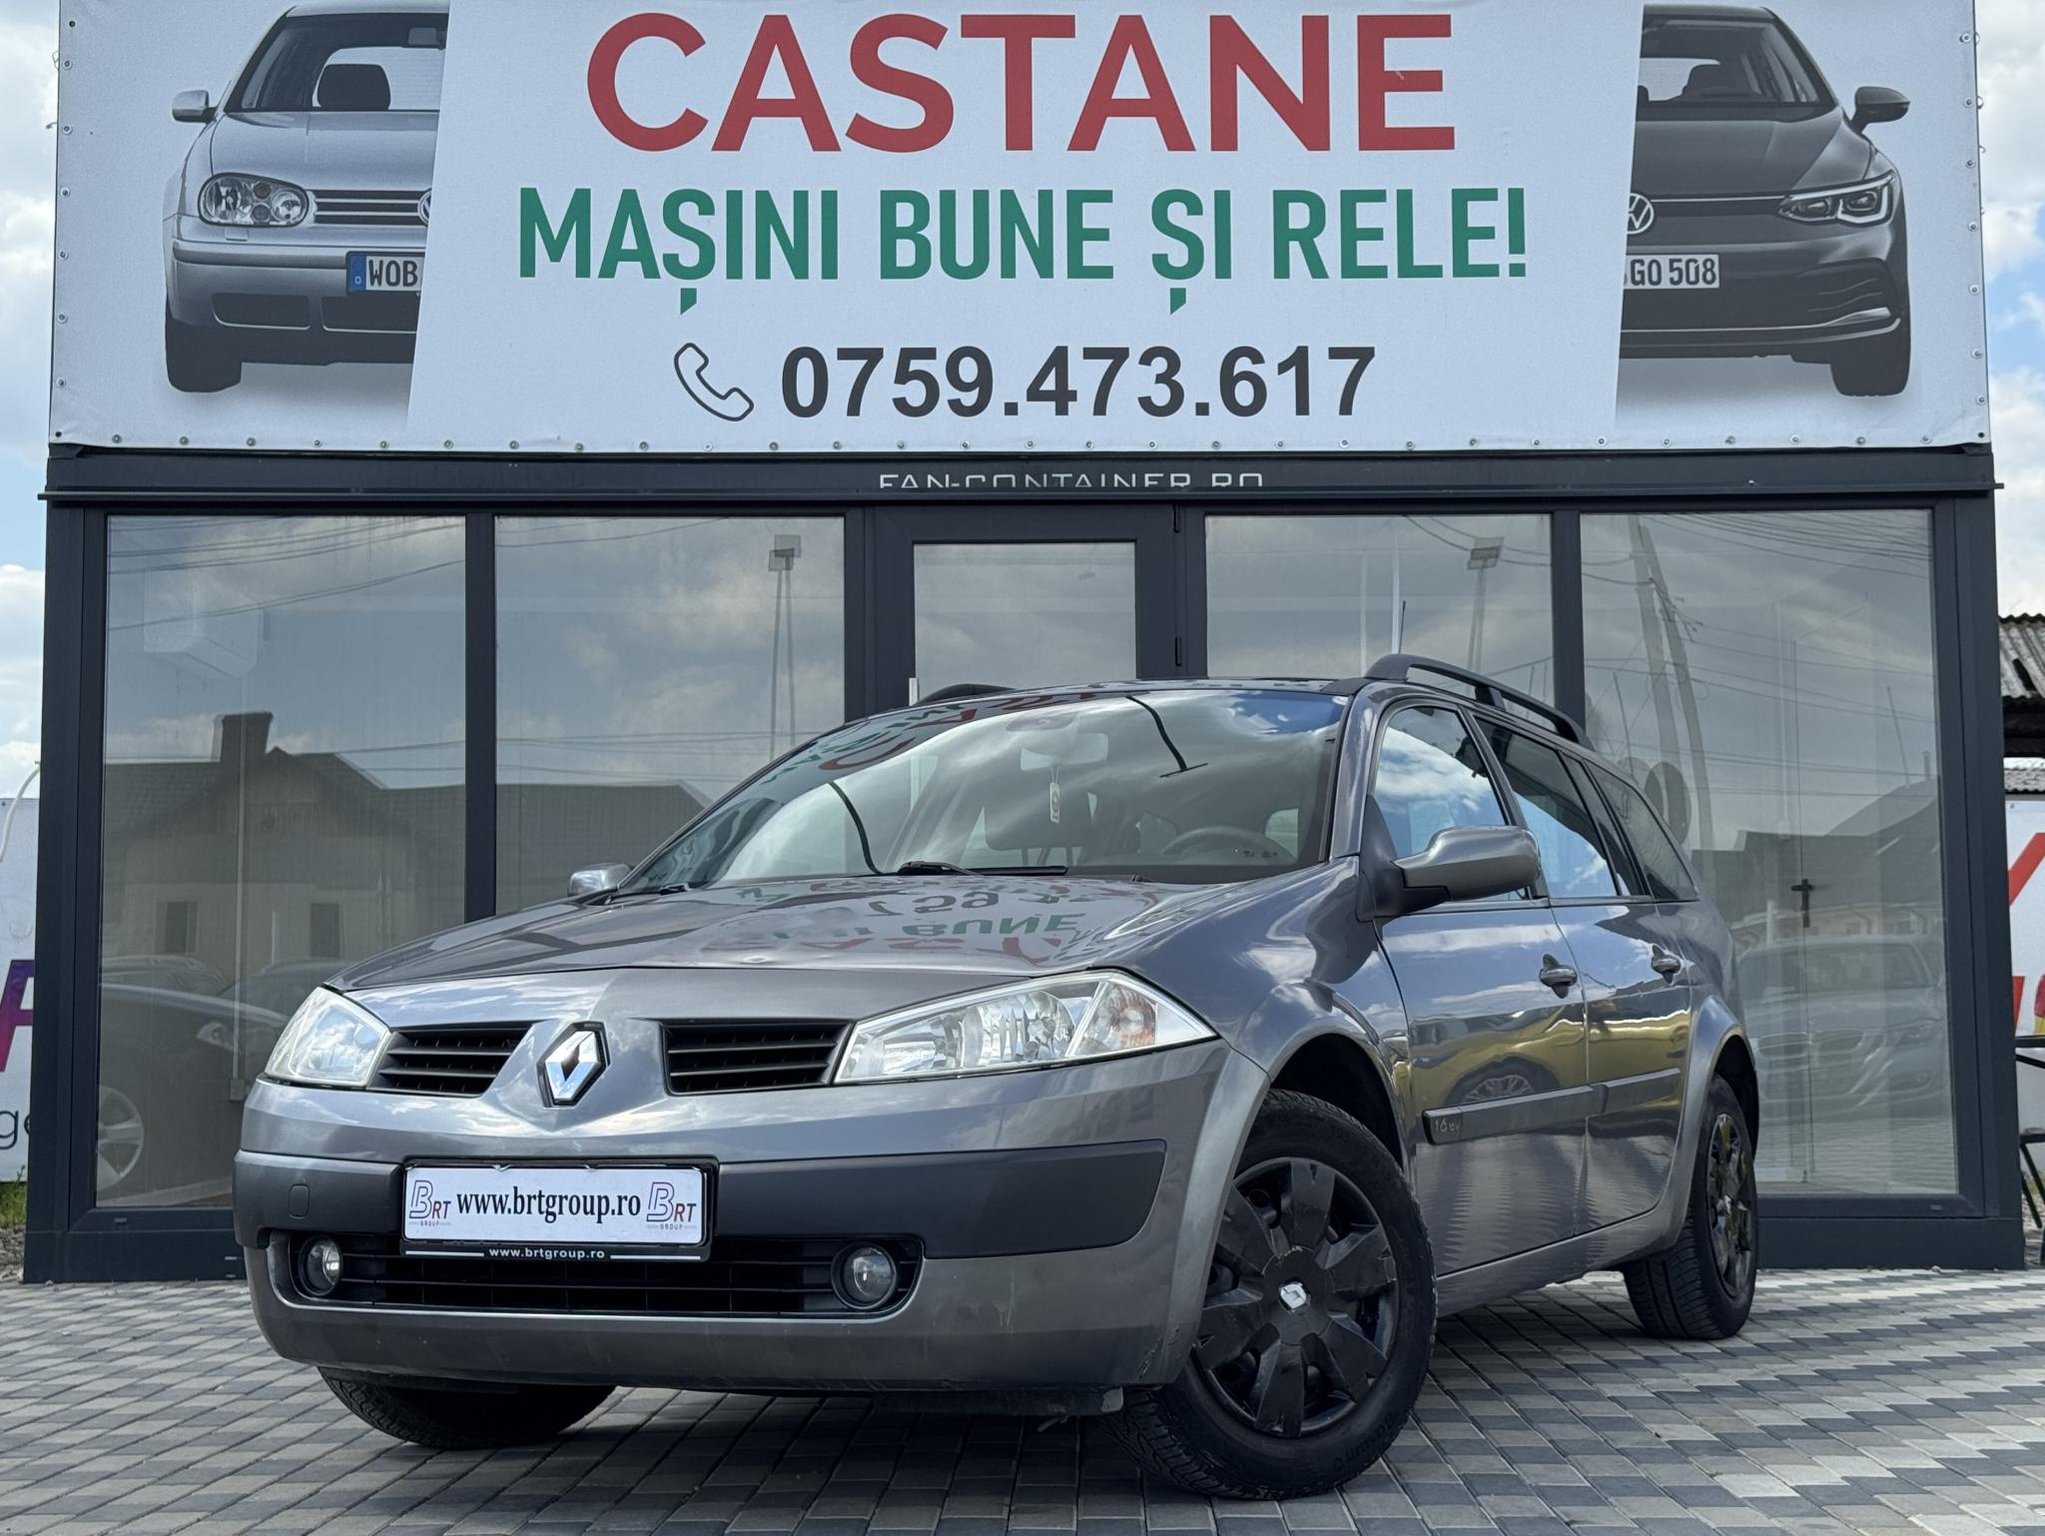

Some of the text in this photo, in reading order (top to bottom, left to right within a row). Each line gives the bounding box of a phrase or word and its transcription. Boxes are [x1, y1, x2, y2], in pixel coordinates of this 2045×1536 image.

[589, 14, 1453, 152] CASTANE
[520, 187, 1525, 315] MAȘINI BUNE ȘI RELE!
[368, 259, 418, 287] WOB
[1630, 258, 1717, 286] GO 508
[781, 345, 1376, 418] 0759.473.617
[456, 1185, 641, 1224] www.brtgroup.ro
[488, 1246, 606, 1261] www.brtgroup.ro
